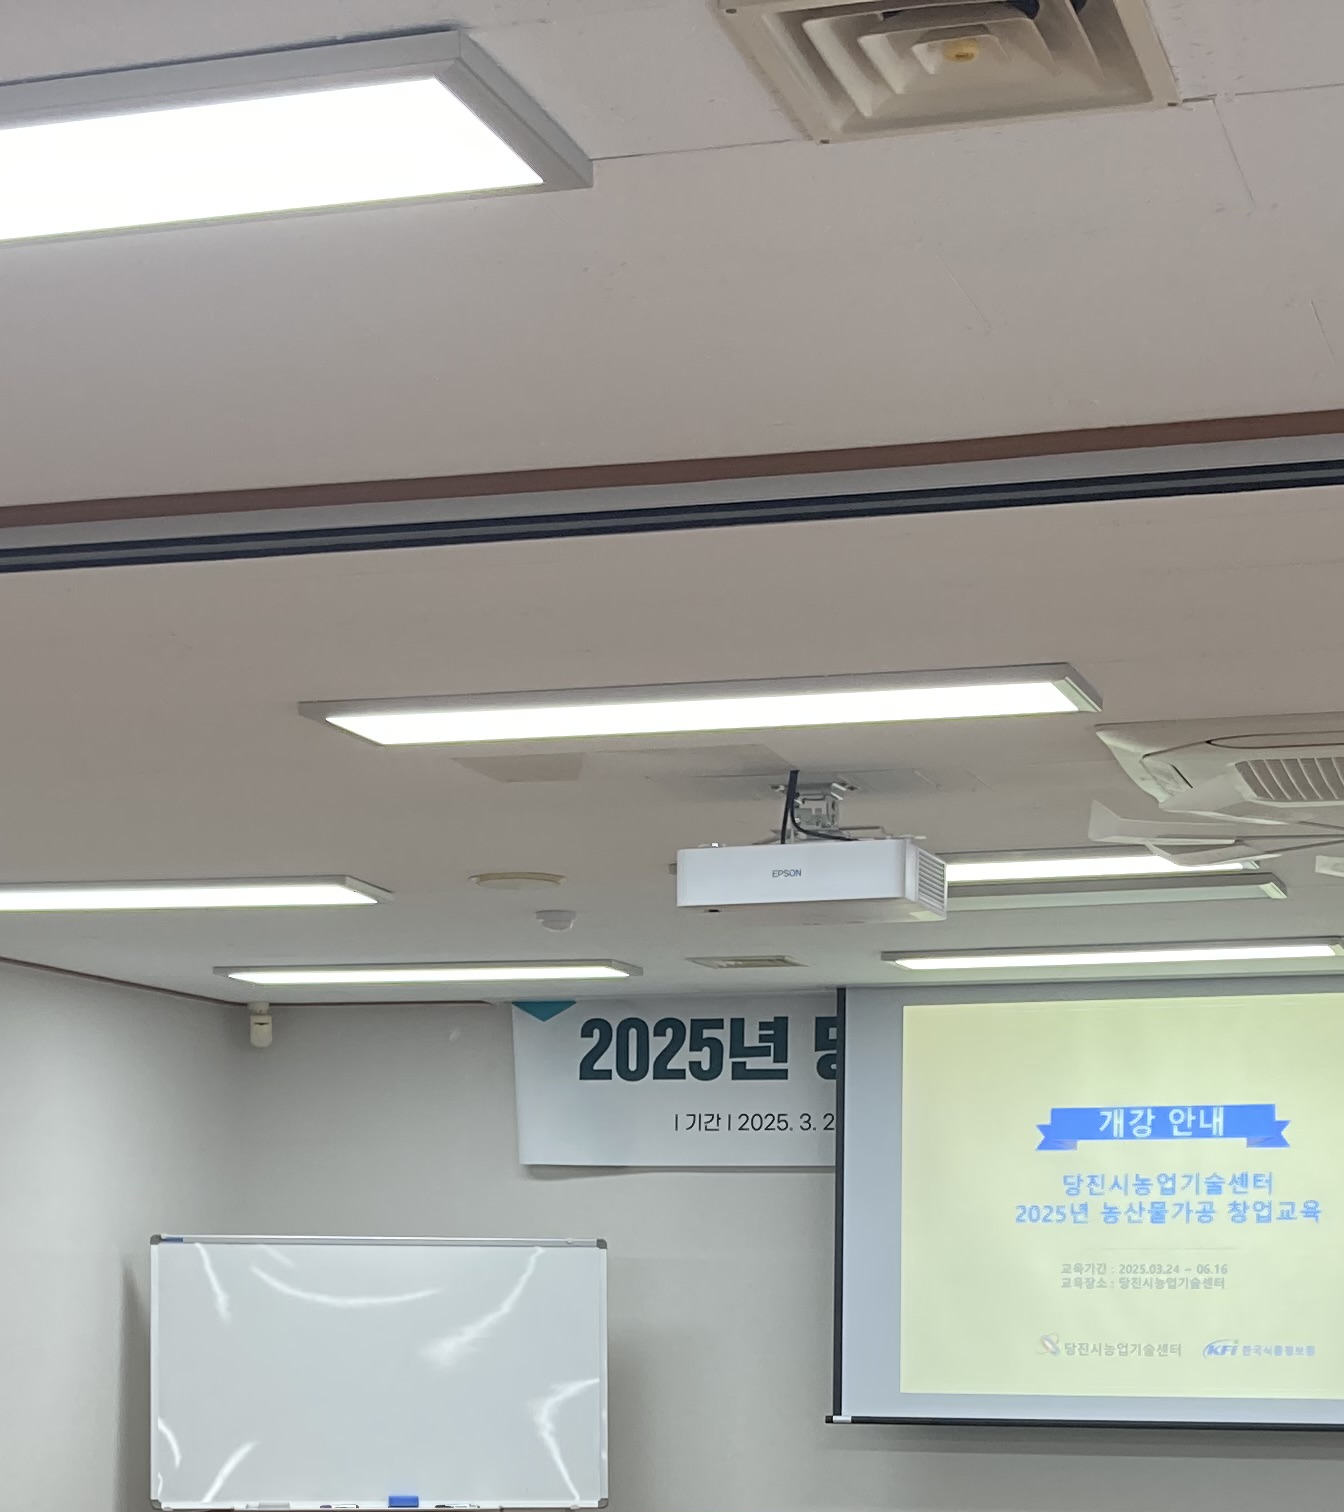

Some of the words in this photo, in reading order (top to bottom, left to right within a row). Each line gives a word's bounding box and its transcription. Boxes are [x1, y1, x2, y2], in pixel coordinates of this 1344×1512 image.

[771, 868, 802, 878] EPSON
[578, 1015, 790, 1083] 2025년
[685, 1112, 723, 1132] 기간
[737, 1112, 794, 1132] 2025.
[798, 1112, 817, 1132] 3.
[1098, 1107, 1157, 1138] 개강
[1167, 1106, 1225, 1137] 안내
[1061, 1171, 1274, 1197] 당진시농업기술센터
[1014, 1202, 1090, 1225] 2025년
[1099, 1200, 1217, 1225] 농산물가공
[1227, 1199, 1323, 1224] 창업교육
[1059, 1262, 1108, 1276] 교육기간
[1118, 1263, 1180, 1275] 2025.03.24
[1195, 1262, 1229, 1275] 06.16
[1059, 1277, 1108, 1290] 교육장소
[1118, 1276, 1226, 1290] 당진시농업기술센터
[1063, 1342, 1183, 1358] 당진시농업기술센터
